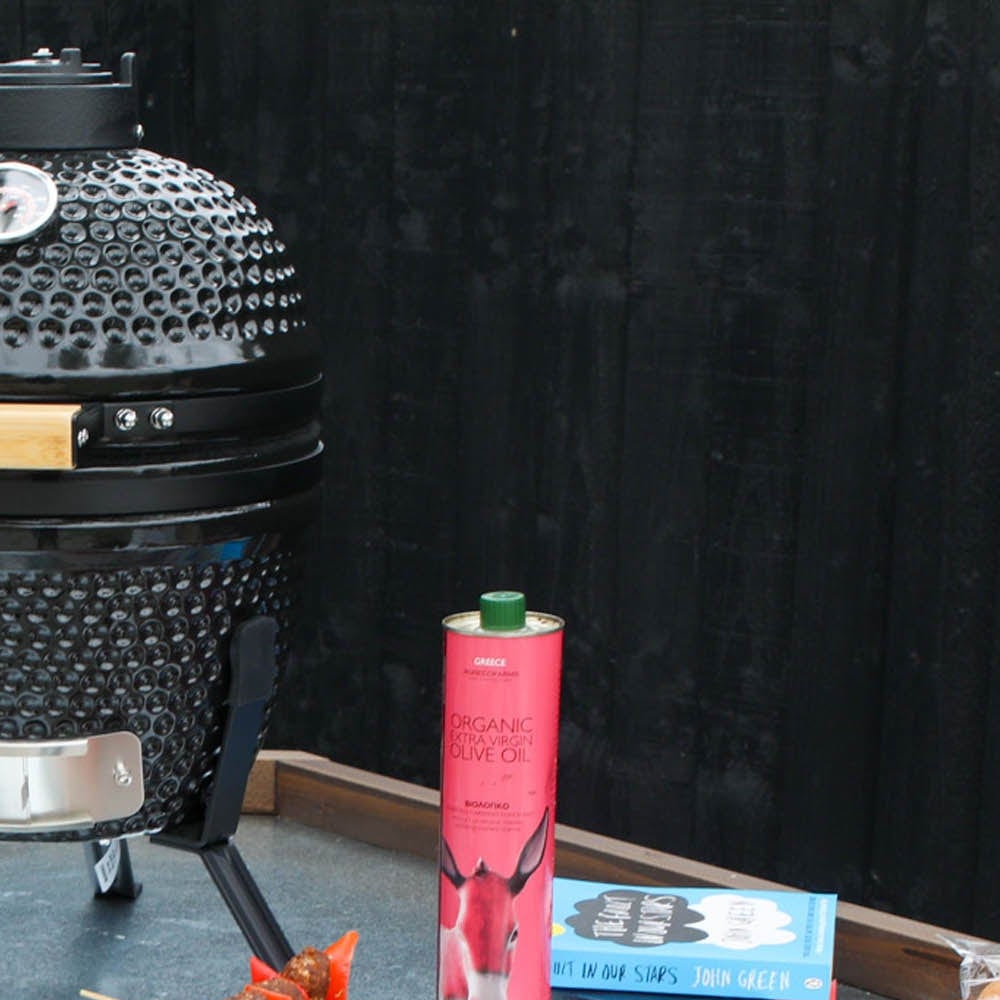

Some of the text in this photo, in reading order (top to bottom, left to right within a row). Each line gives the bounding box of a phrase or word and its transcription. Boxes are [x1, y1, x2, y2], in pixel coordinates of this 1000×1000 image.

[450, 712, 533, 733] ORGANIC
[451, 729, 533, 747] EXTRA VIRGIN
[450, 742, 530, 763] OLIVE OIL
[582, 962, 597, 980] IN
[602, 963, 626, 982] OUR
[634, 964, 678, 985] STARS
[691, 965, 731, 988] JOHN
[737, 968, 791, 991] GREEN
